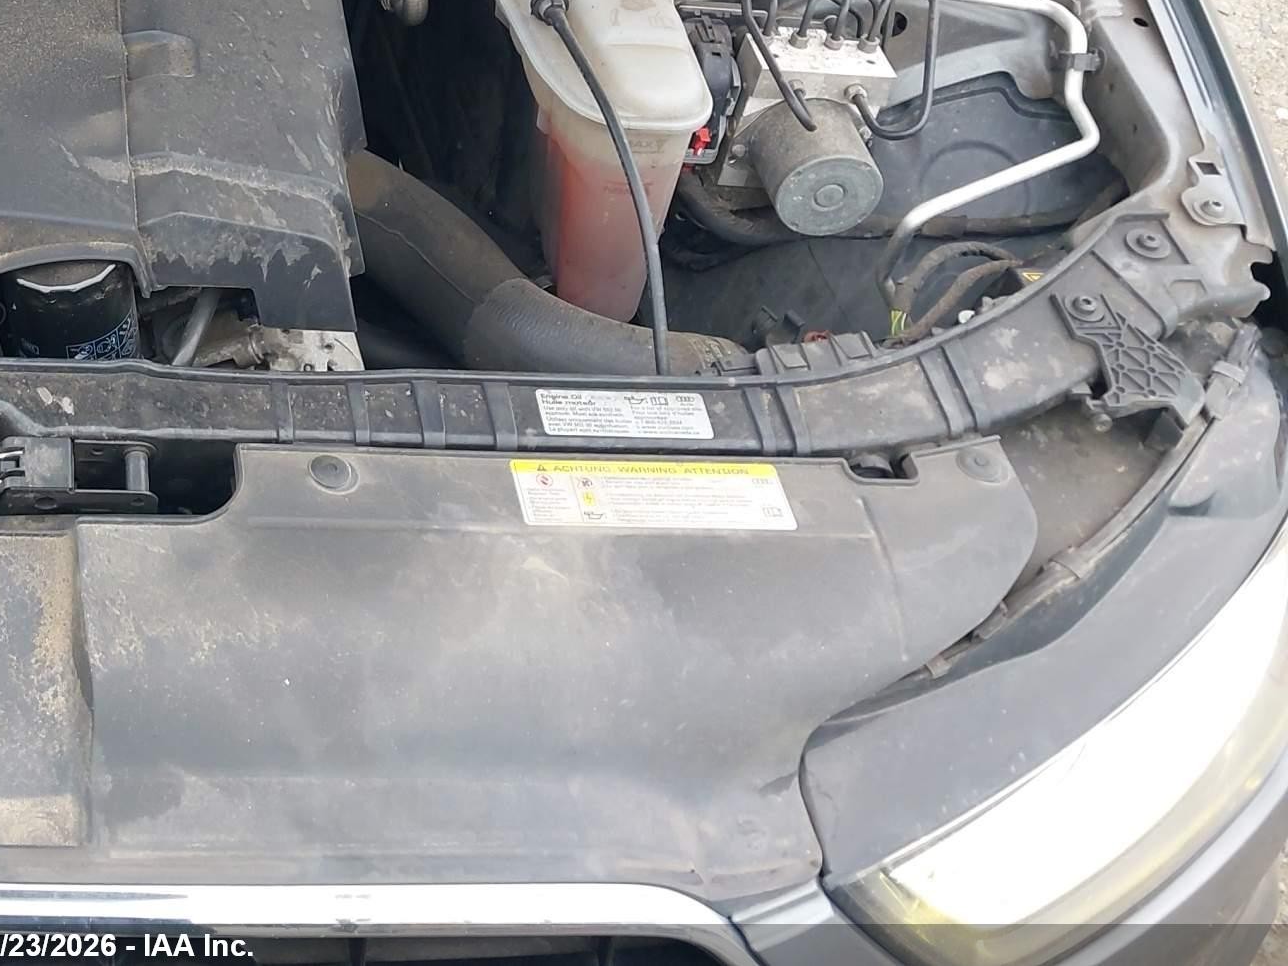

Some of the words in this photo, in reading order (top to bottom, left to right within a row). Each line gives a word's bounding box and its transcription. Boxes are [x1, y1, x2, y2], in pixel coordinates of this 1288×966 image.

[553, 465, 611, 473] ACHTUNG
[617, 466, 677, 474] WARNING
[684, 467, 749, 475] ATTENTION
